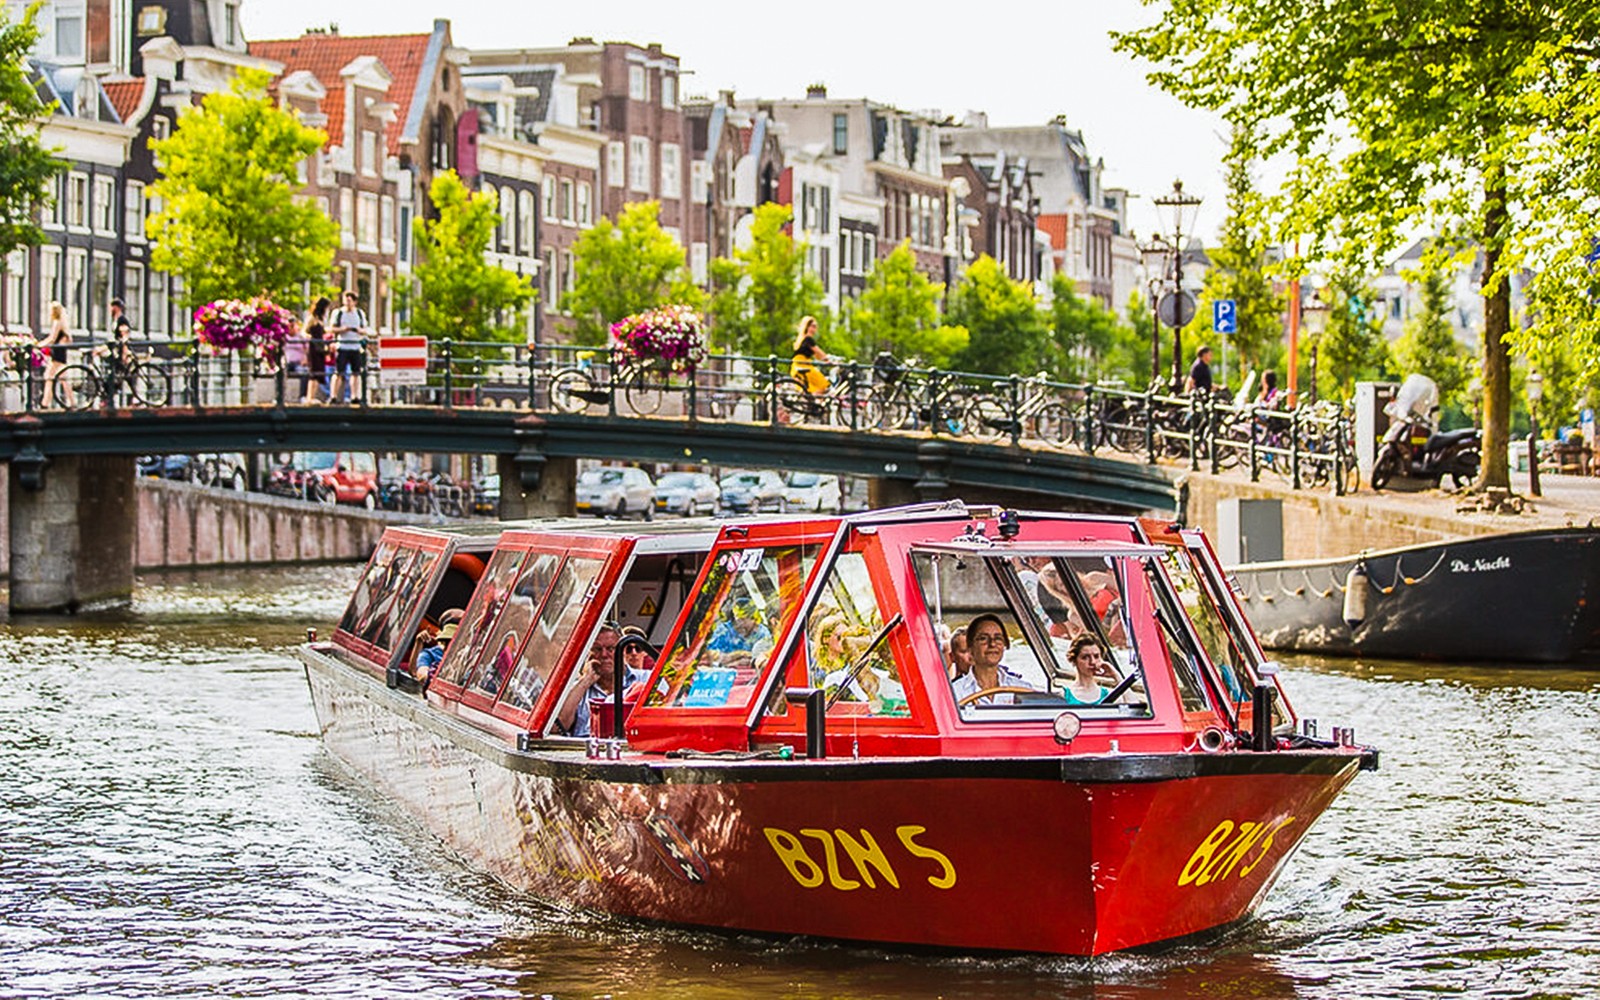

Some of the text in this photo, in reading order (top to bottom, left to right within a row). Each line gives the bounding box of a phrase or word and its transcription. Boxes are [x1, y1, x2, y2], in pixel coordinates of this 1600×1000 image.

[1219, 303, 1231, 319] P
[1450, 556, 1511, 573] De Nacht
[763, 825, 956, 890] BZN 5
[1178, 816, 1296, 886] BZN 5
